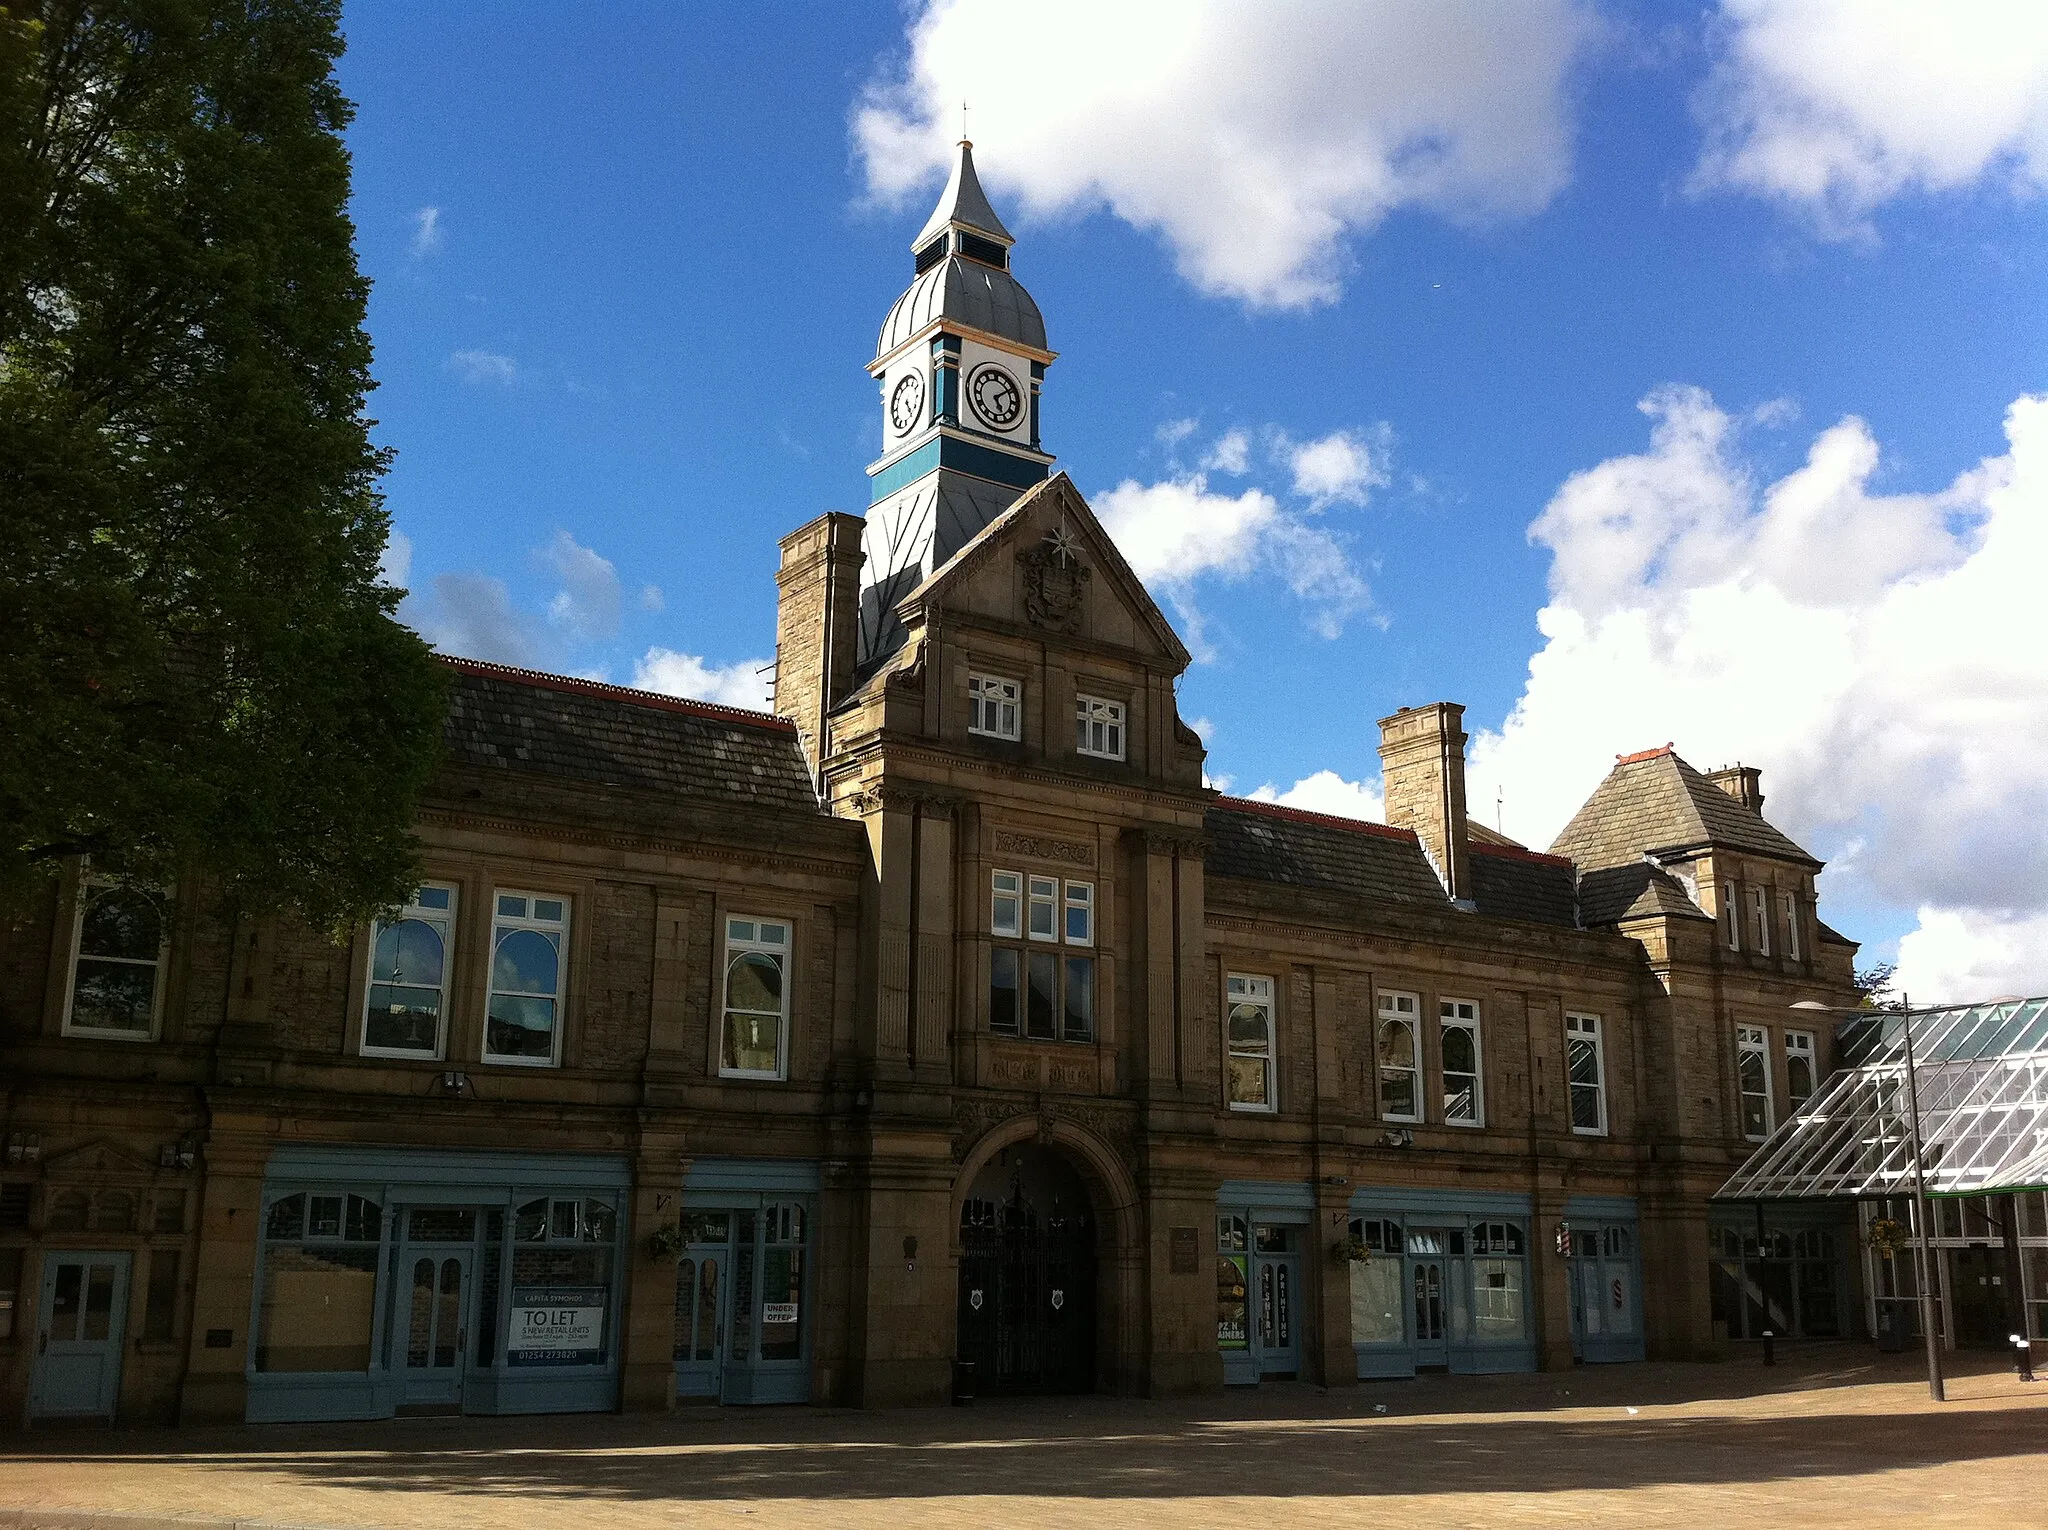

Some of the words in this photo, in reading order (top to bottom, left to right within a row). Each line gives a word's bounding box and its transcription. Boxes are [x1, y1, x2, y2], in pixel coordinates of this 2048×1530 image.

[1264, 1274, 1272, 1339] T-SHIRT
[1279, 1273, 1287, 1338] PRINTING
[524, 1311, 547, 1326] TO
[551, 1311, 578, 1325] LET
[569, 1326, 590, 1334] UNITS
[519, 1351, 544, 1360] 01254
